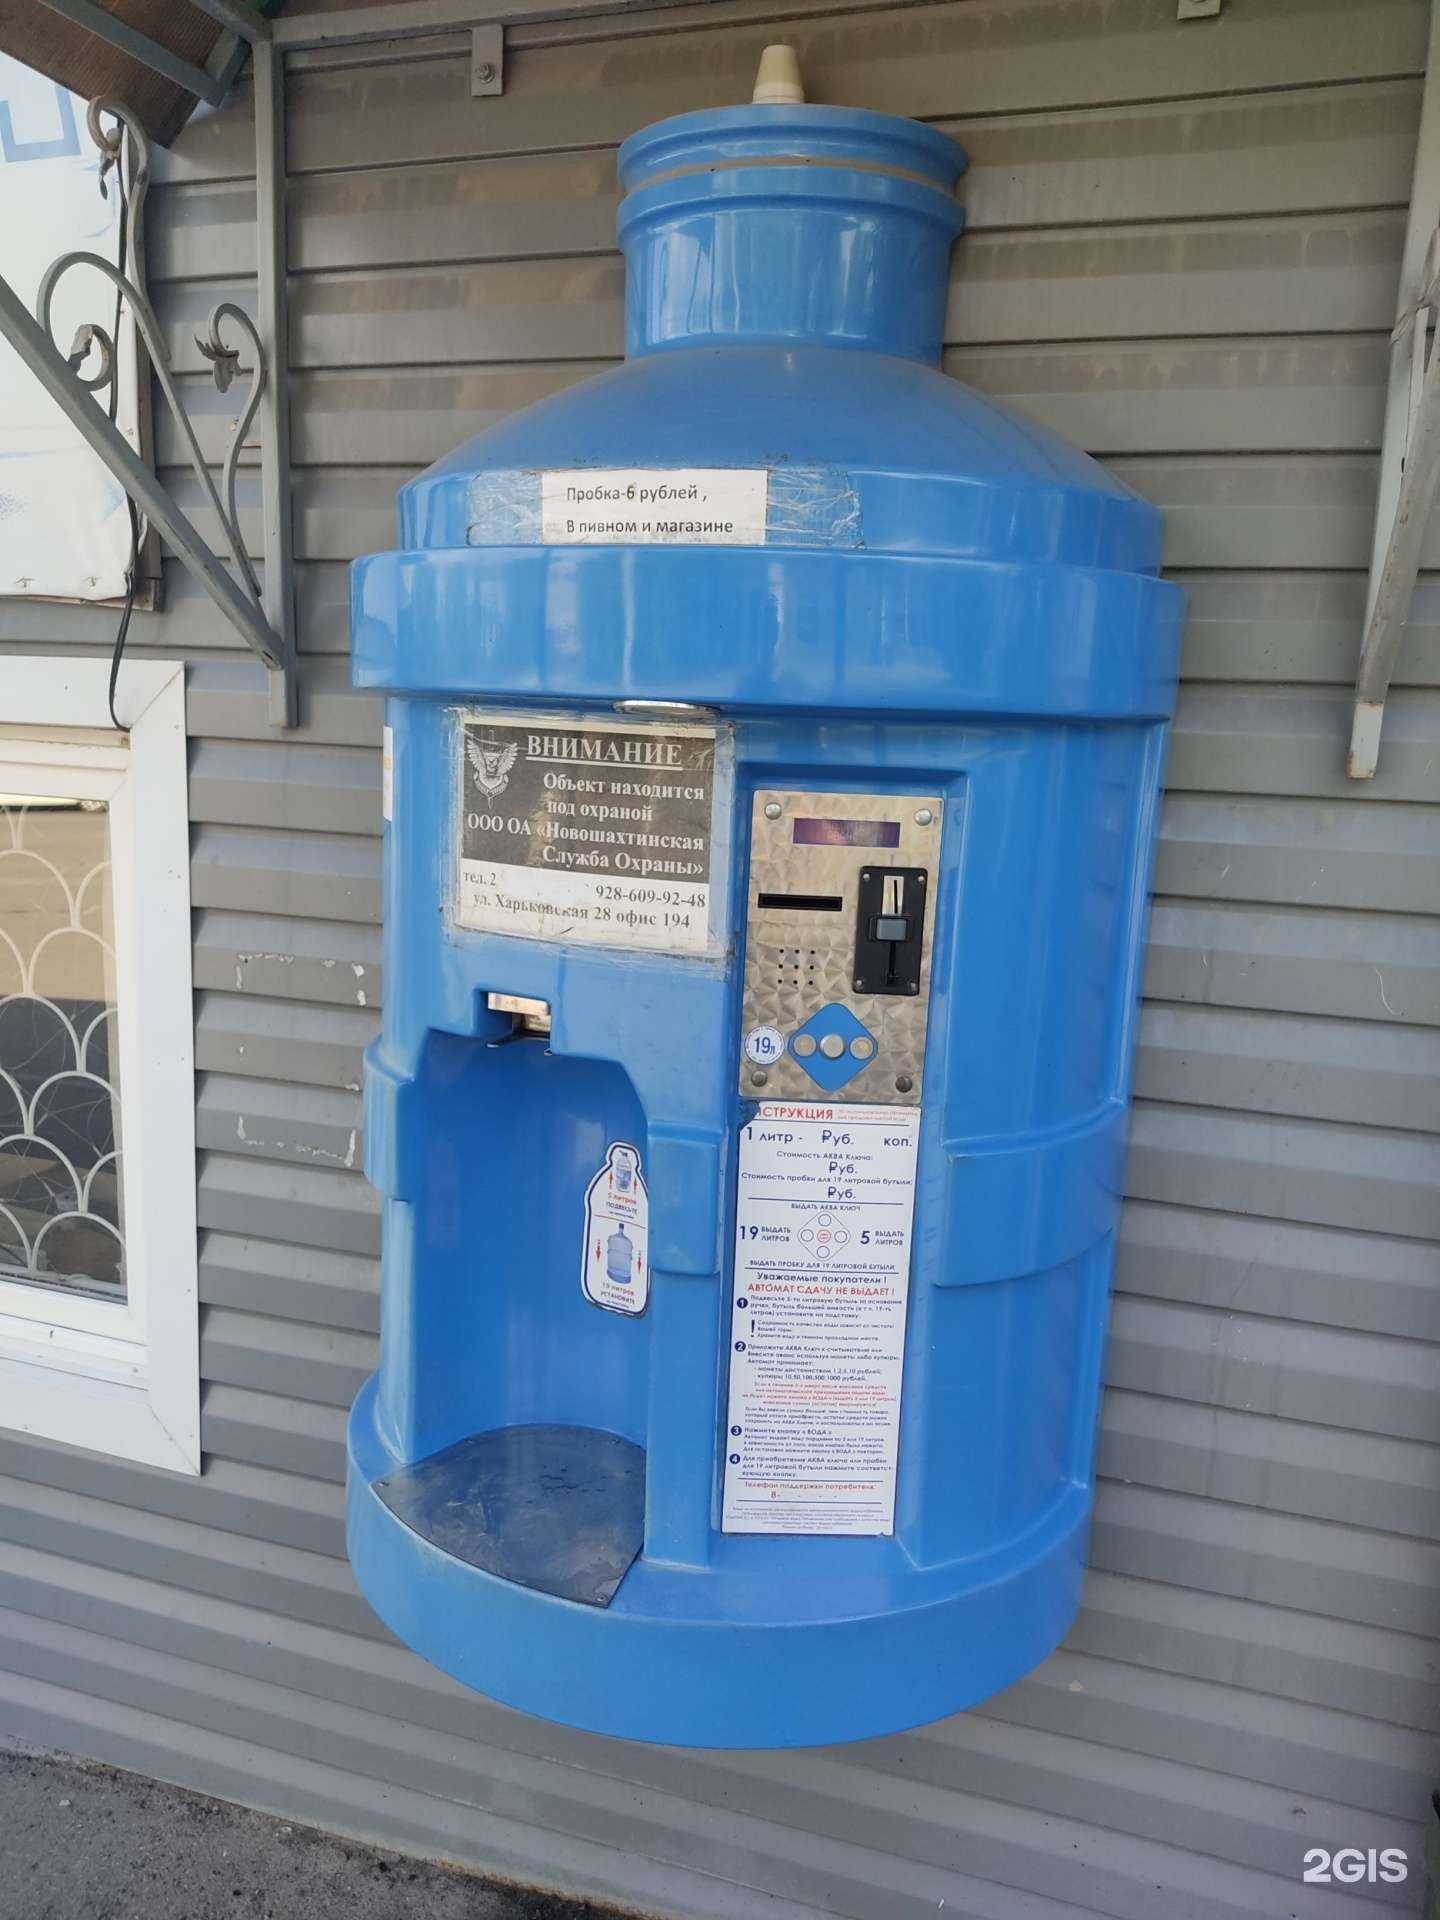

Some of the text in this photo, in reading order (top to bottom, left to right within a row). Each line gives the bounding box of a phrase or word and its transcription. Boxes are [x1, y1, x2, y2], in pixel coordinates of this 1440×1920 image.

[639, 484, 698, 503] рублей
[566, 519, 734, 533] В пивном и магазине
[527, 735, 682, 766] ВНИМАНИЕ
[543, 772, 705, 801] Объект находится
[547, 801, 653, 822] под охраной
[467, 813, 705, 851] ООО ОА «Новошахтинская
[542, 845, 704, 875] Служба Охраны»
[463, 872, 489, 885] тел.
[595, 884, 706, 908] 928-609-92-48
[473, 894, 690, 929] ул. Харьковская 28 офис 194
[746, 1126, 753, 1141] 1
[759, 1132, 793, 1144] литр
[883, 1137, 912, 1148] коп.
[739, 1225, 759, 1240] 19
[860, 1230, 870, 1245] 5
[747, 1283, 794, 1293] АВТОМАТ
[797, 1285, 833, 1295] СДАЧУ
[836, 1286, 848, 1295] НЕ
[757, 1272, 818, 1282] Уважаемые
[821, 1275, 882, 1285] покупатели
